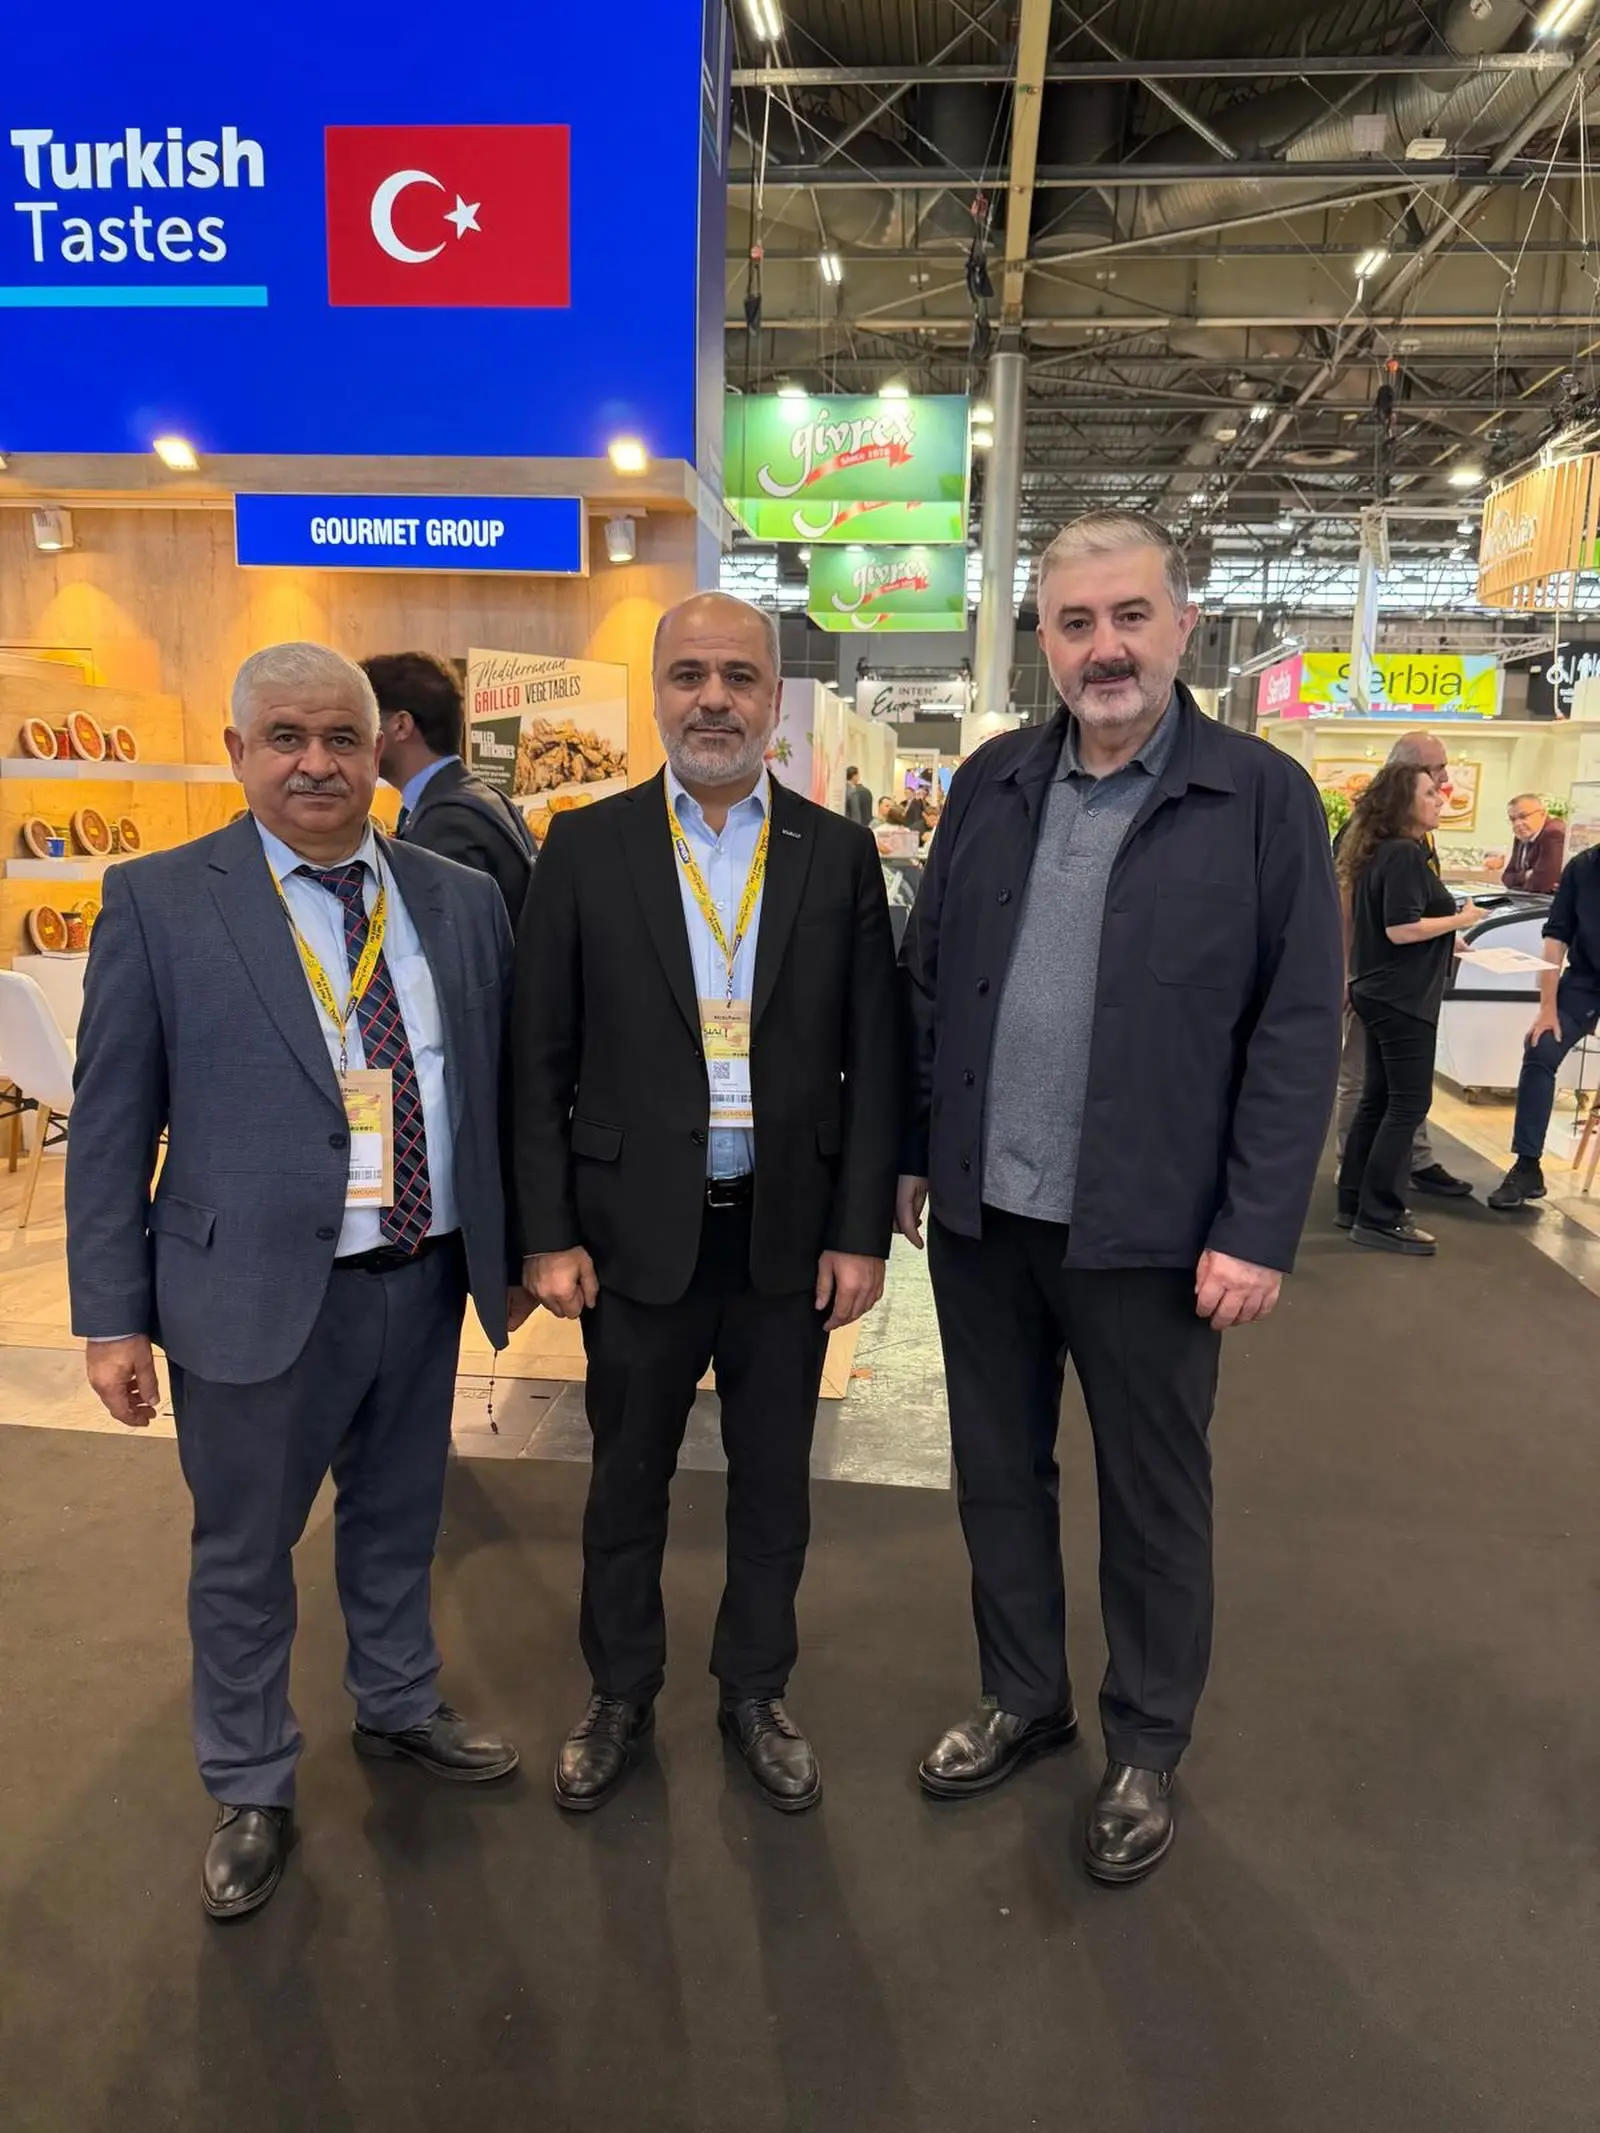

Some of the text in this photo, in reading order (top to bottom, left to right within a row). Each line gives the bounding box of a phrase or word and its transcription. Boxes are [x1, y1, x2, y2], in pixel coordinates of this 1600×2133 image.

[10, 126, 265, 190] Turkish
[14, 202, 228, 263] Tastes
[757, 408, 916, 498] givrex
[310, 517, 505, 547] GOURMET GROUP
[470, 659, 567, 688] Mediterranean
[474, 675, 581, 714] GRILLED VEGETABLES
